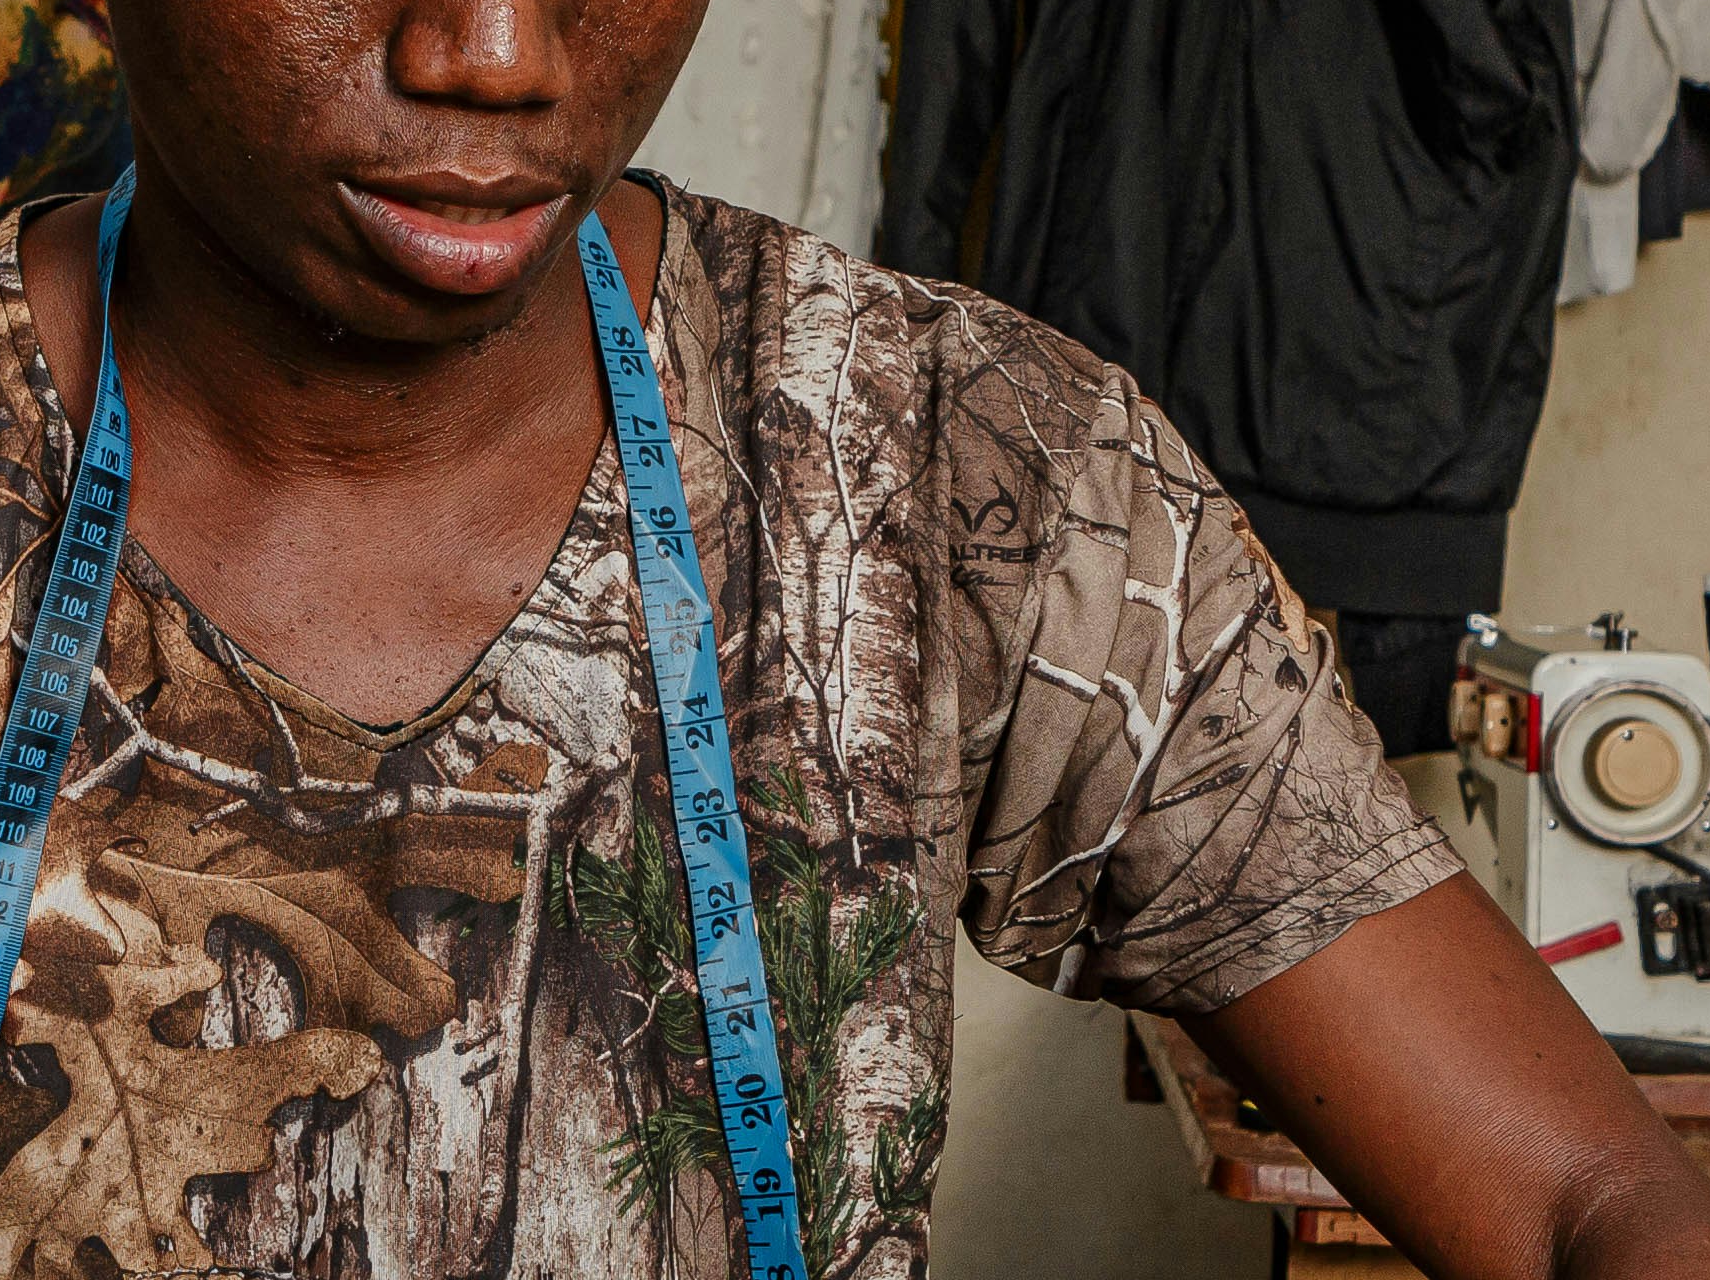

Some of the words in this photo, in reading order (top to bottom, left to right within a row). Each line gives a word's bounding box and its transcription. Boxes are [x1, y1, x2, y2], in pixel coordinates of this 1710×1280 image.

[587, 240, 619, 291] 29
[611, 326, 645, 378] 28
[100, 446, 121, 470] 100
[632, 413, 666, 468] 27
[91, 483, 114, 508] 101
[81, 521, 107, 547] 102
[649, 505, 686, 560] 26
[71, 558, 98, 583] 103
[61, 594, 88, 620] 104
[664, 597, 703, 655] 25
[50, 631, 80, 658] 105
[40, 669, 70, 695] 106
[29, 707, 60, 732] 107
[682, 691, 715, 751] 24
[18, 743, 47, 769] 108
[7, 782, 36, 807] 109
[693, 786, 729, 845] 23
[707, 879, 741, 941] 22
[720, 976, 758, 1036] 21
[734, 1073, 773, 1131] 20
[752, 1167, 785, 1221] 19
